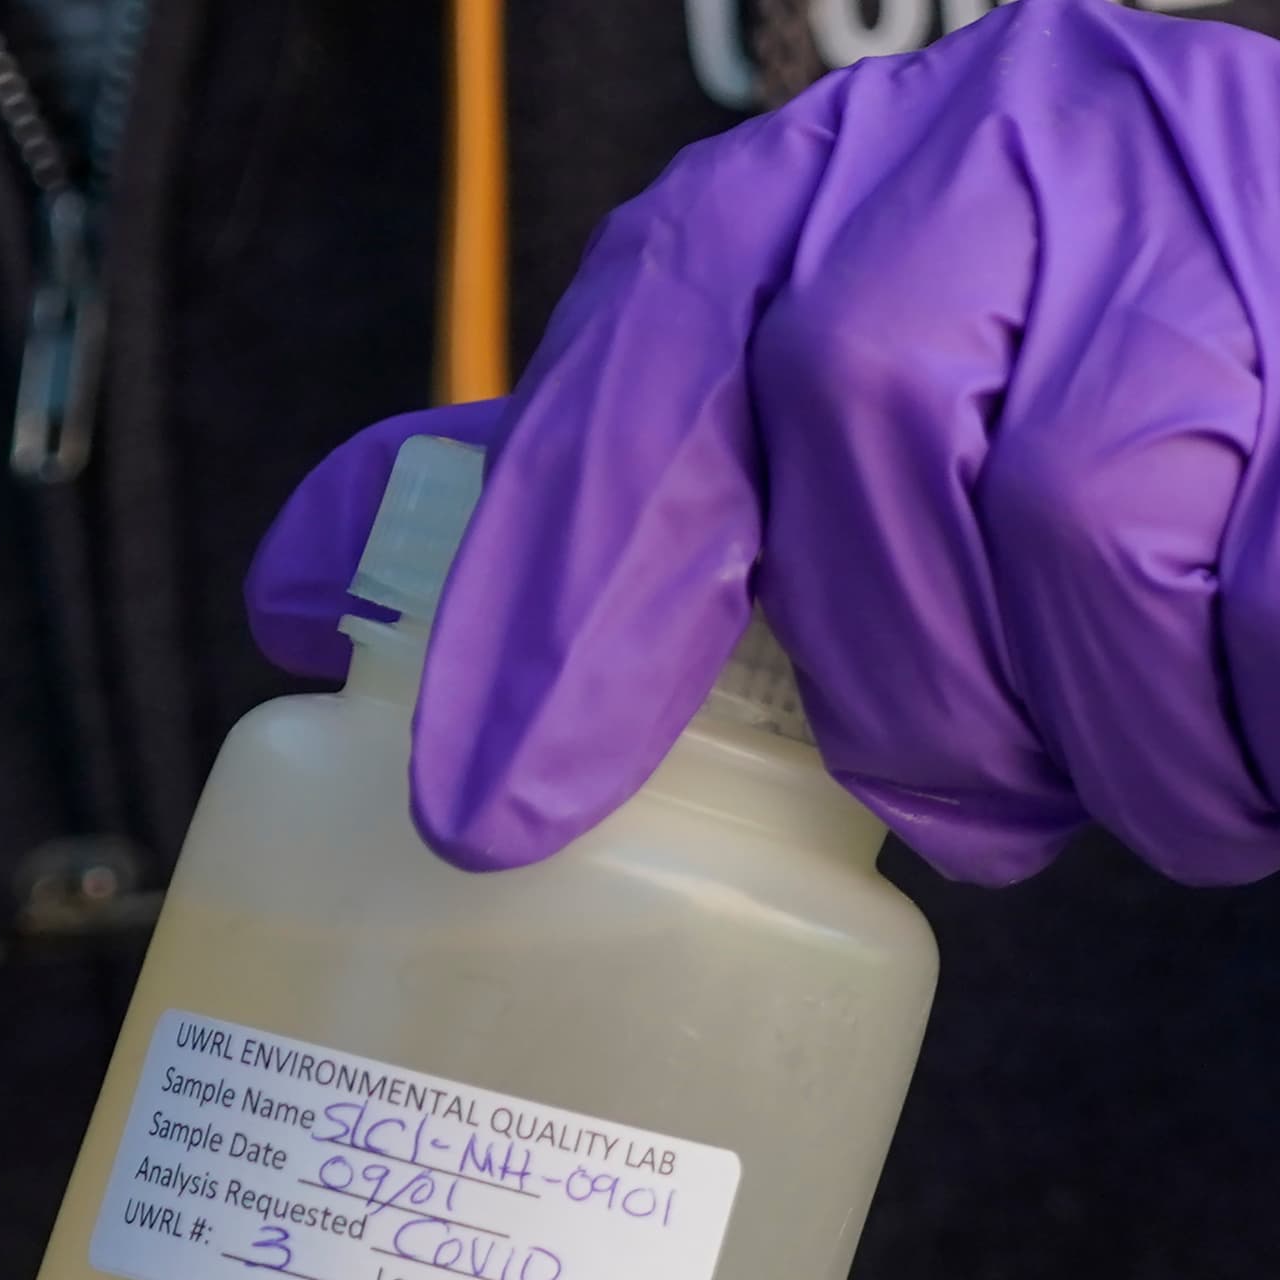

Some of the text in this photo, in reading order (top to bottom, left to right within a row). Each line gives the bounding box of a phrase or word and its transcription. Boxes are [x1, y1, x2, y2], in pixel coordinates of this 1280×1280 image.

[161, 1067, 315, 1130] Sample Name
[175, 1021, 678, 1176] UWRL ENVIRONMENTAL QUALITY LAB
[148, 1111, 287, 1170] Sample Date
[135, 1157, 368, 1241] Analysis Requested
[318, 1155, 456, 1216] 09/01
[124, 1199, 213, 1246] UWRL #:
[245, 1226, 293, 1271] 3
